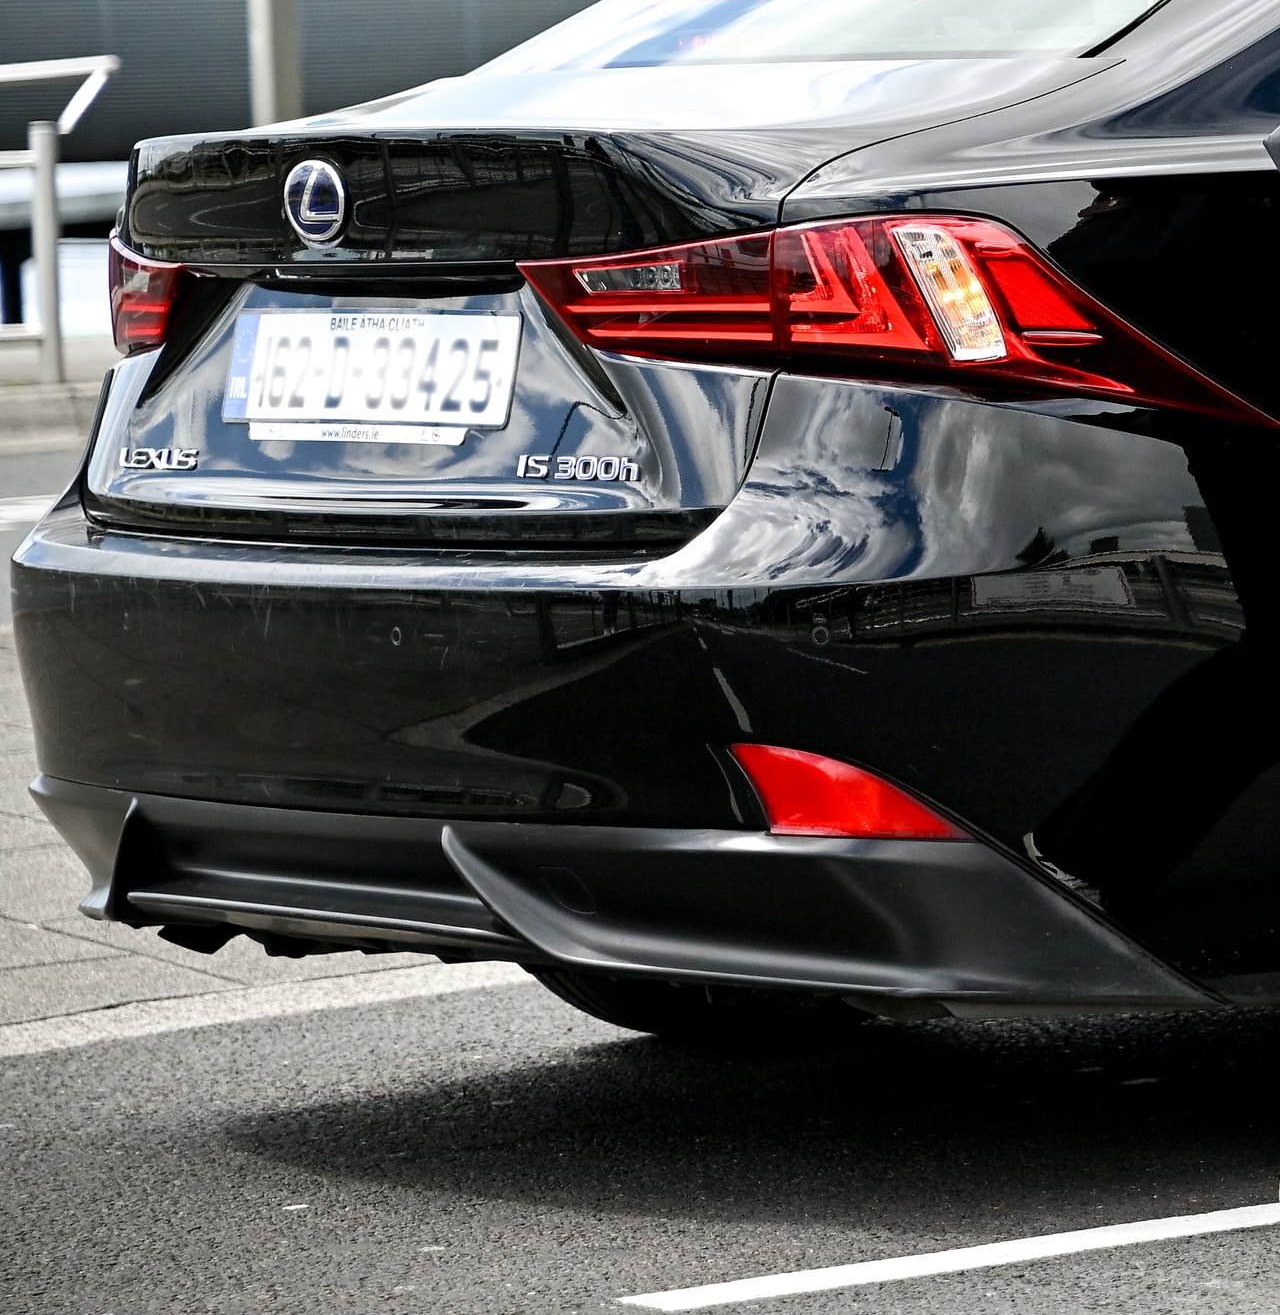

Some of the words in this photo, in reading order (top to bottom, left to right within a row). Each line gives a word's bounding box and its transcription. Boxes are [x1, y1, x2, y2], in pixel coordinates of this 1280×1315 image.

[330, 317, 358, 331] BAILE
[360, 315, 385, 331] ÁTHA
[228, 375, 248, 400] IRL
[320, 426, 380, 441] www.linders.ie
[119, 447, 199, 470] LEXUS
[516, 453, 550, 478] IS
[554, 455, 640, 482] 300h
